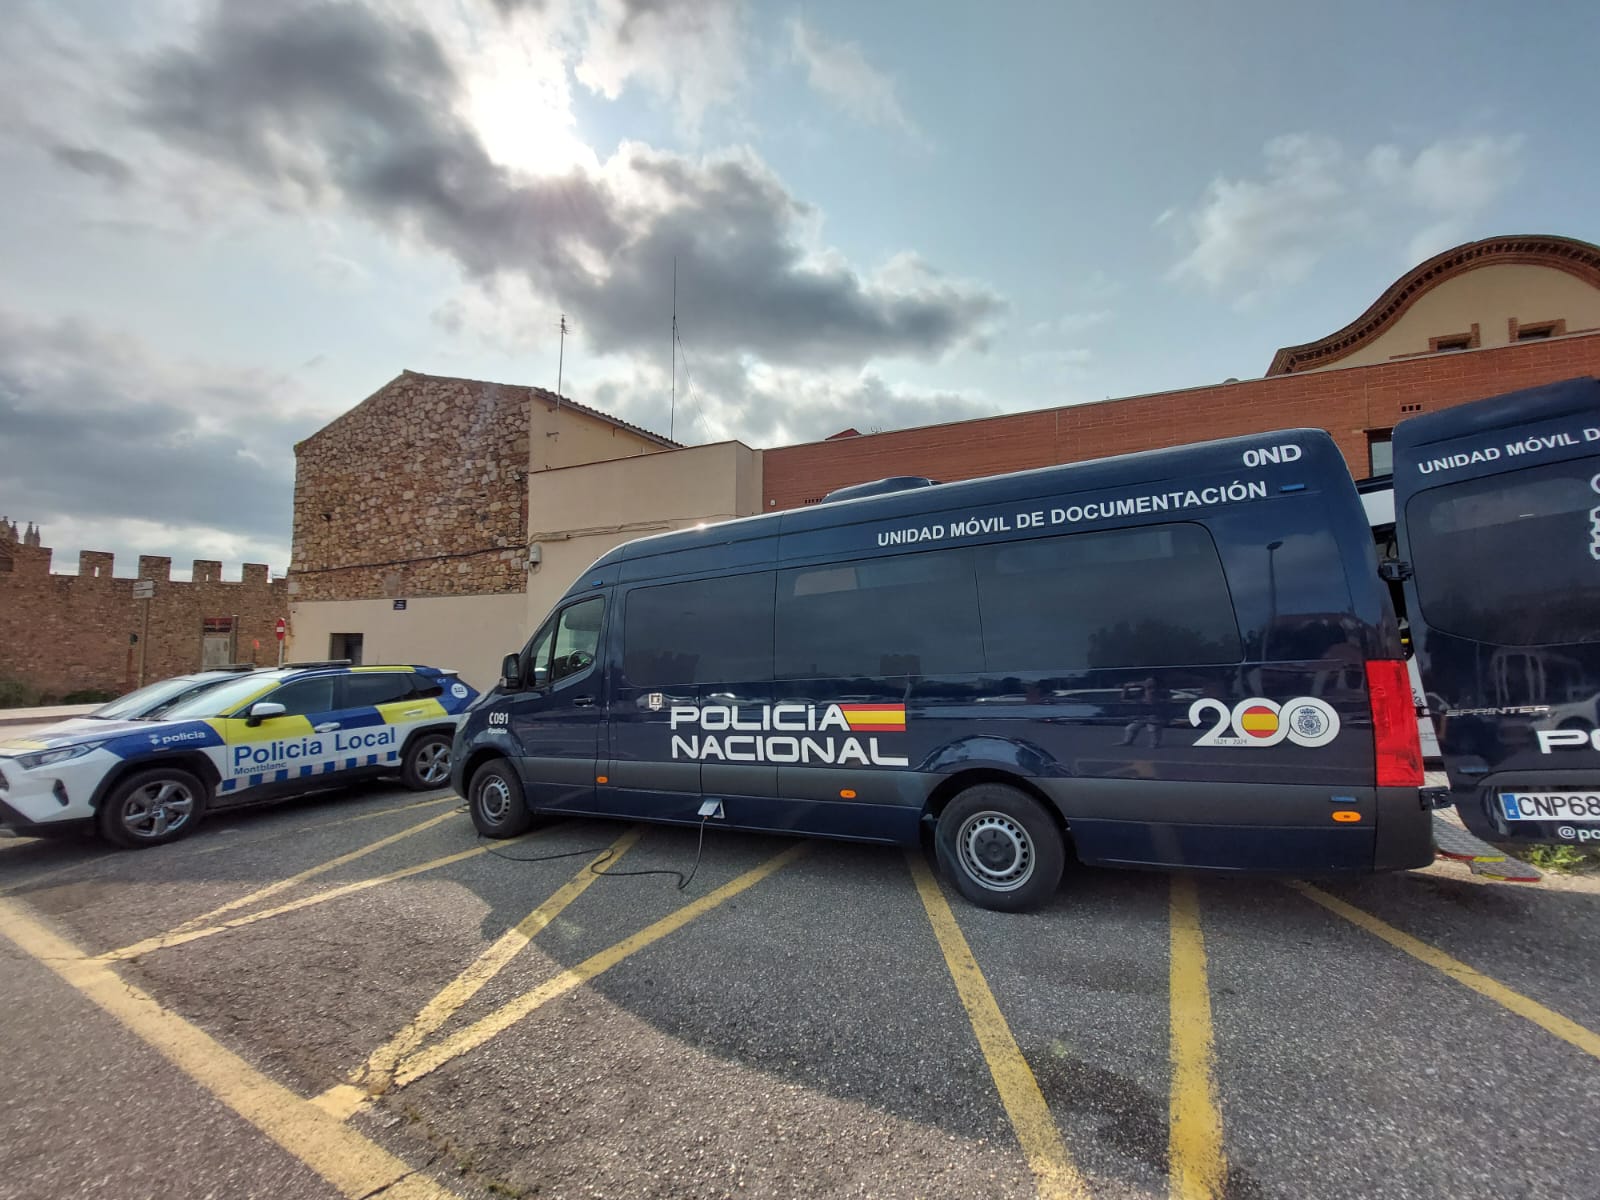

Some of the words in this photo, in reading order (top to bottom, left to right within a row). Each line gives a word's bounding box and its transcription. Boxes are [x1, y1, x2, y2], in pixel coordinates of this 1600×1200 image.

[1418, 447, 1500, 474] UNIDAD
[1506, 433, 1580, 457] MÓVIL
[877, 524, 945, 546] UNIDAD
[950, 515, 1011, 537] MÓVIL
[1016, 510, 1045, 529] DE
[1051, 480, 1268, 524] DOCUMENTACIÓN
[1188, 696, 1341, 748] 200
[1445, 705, 1551, 717] SPRINTER
[162, 731, 207, 745] policia
[234, 737, 323, 767] Policia
[335, 726, 396, 751] Local
[671, 734, 909, 766] NACIONAL
[1537, 728, 1600, 754] P
[234, 762, 287, 776] Montblanc
